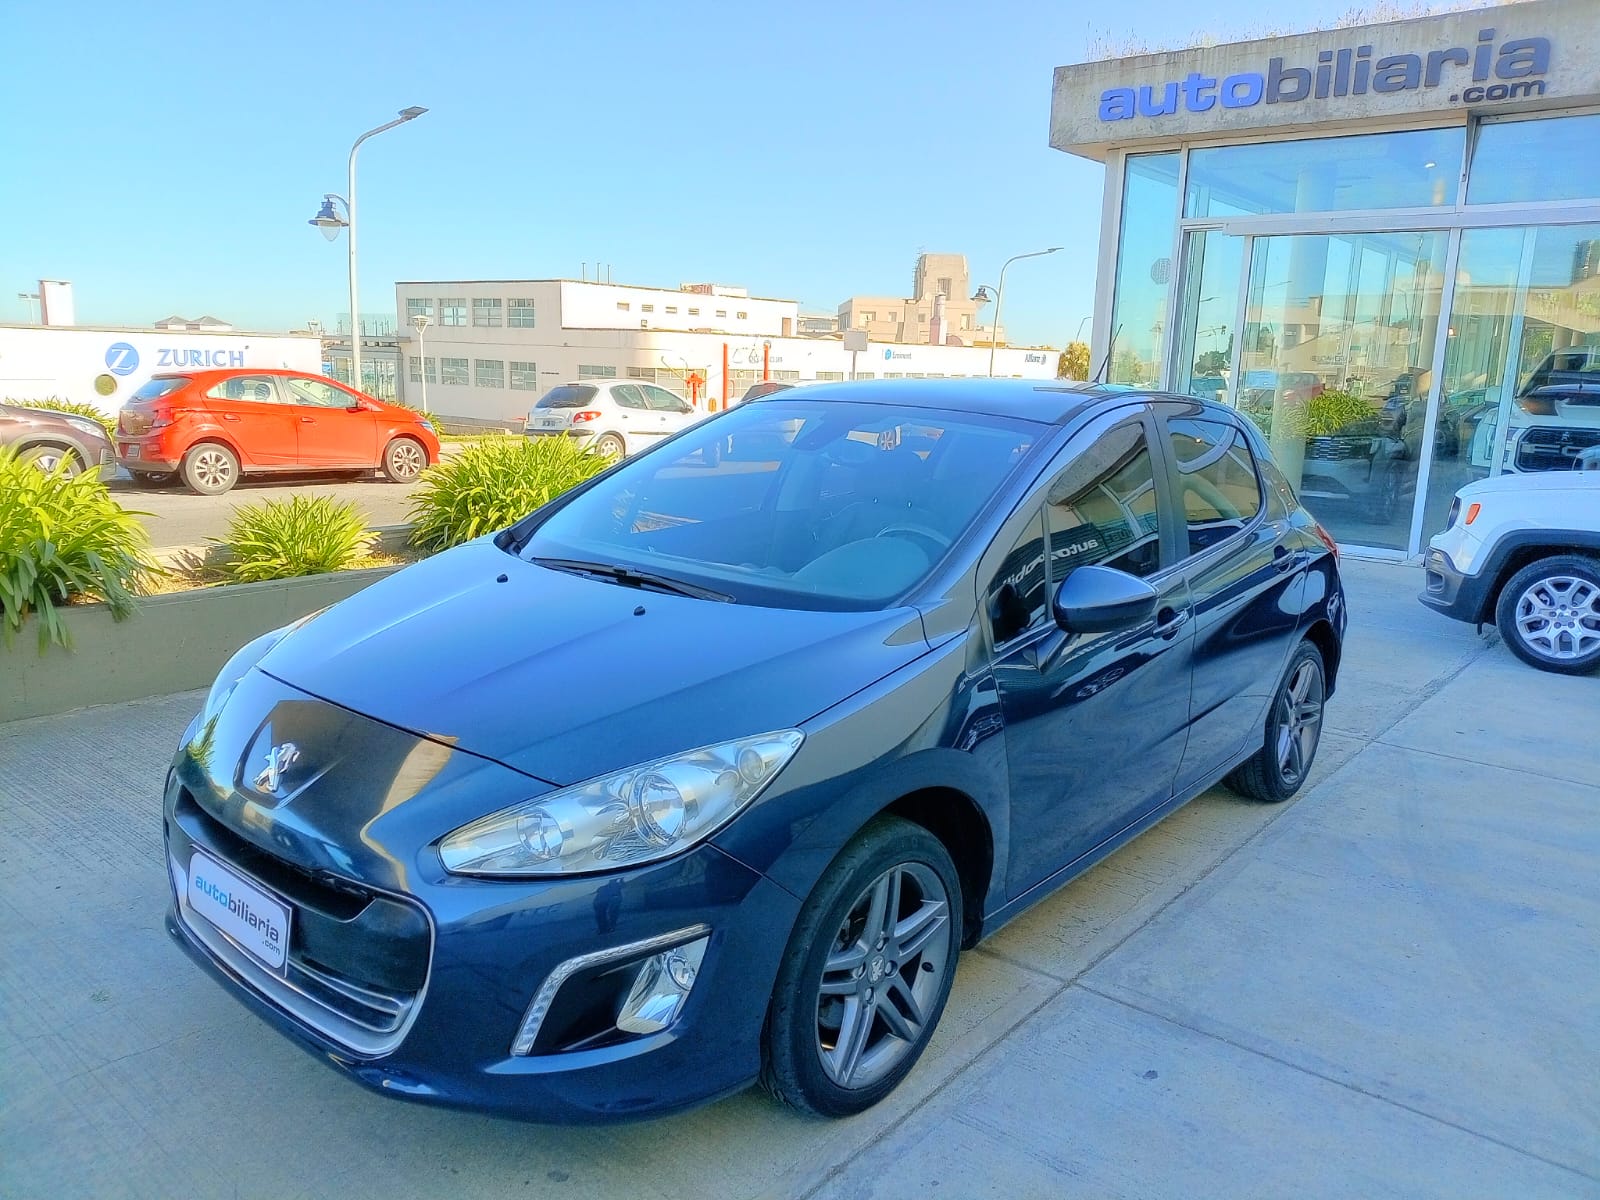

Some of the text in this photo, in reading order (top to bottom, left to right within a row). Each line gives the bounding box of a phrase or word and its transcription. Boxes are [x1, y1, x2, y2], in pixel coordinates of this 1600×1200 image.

[1099, 28, 1551, 121] autobiliaria
[1449, 79, 1546, 104] .com
[157, 348, 244, 368] ZURICH
[195, 876, 279, 942] autobiliaria
[262, 940, 280, 955] .com
